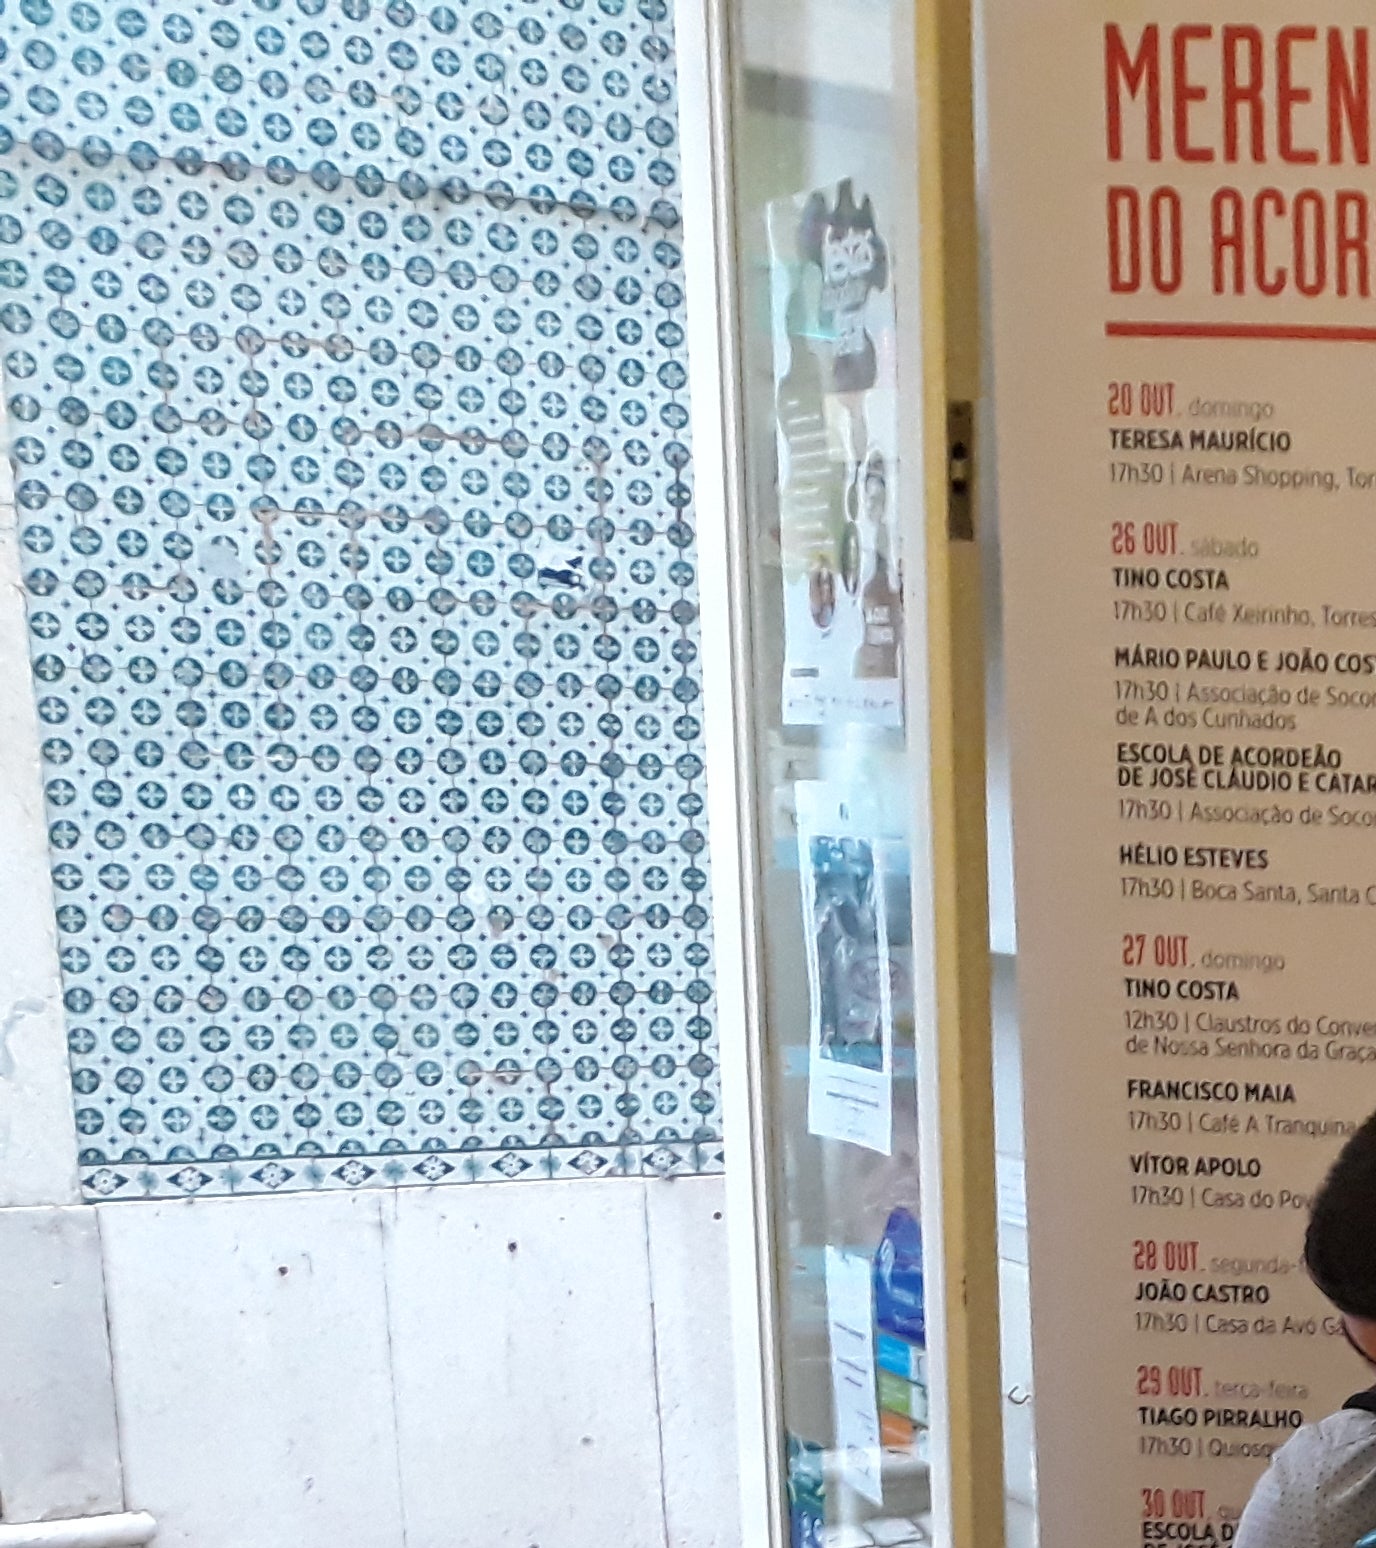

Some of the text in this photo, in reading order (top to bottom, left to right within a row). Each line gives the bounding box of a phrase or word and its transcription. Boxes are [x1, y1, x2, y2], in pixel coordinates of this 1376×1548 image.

[1108, 185, 1181, 295] DO
[1108, 382, 1131, 416] 20
[1189, 399, 1273, 421] domingo
[1109, 429, 1291, 452] TERESA MAURÍCIO
[1109, 463, 1163, 483] 17h30
[1182, 463, 1237, 486] Arena
[1244, 465, 1339, 491] Shopping,
[1112, 522, 1135, 555] 26
[1191, 535, 1258, 557] sábado
[1113, 568, 1229, 590] TINO COSTA
[1114, 601, 1166, 622] 17h30
[1185, 601, 1226, 623] Café
[1322, 606, 1376, 628] Torres
[1115, 644, 1179, 668] MÁRIO
[1185, 649, 1250, 670] PAULO
[1257, 651, 1268, 670] E
[1277, 647, 1327, 672] JOÃO
[1114, 680, 1168, 701] 17h30
[1187, 683, 1290, 706] Associação
[1296, 687, 1318, 705] de
[1116, 706, 1296, 730] de A dos Cunhados
[1118, 743, 1341, 768] ESCOLA DE ACORDEÃO
[1119, 768, 1143, 787] DE
[1150, 765, 1197, 788] JOSÉ
[1203, 767, 1291, 791] CLÁUDIO
[1299, 773, 1310, 792] E
[1119, 800, 1171, 819] 17h30
[1191, 806, 1293, 826] Associação
[1299, 807, 1322, 825] de
[1120, 842, 1268, 869] HÉLIO ESTEVES
[1122, 878, 1173, 897] 17h30
[1192, 880, 1236, 900] Boca
[1244, 883, 1301, 903] Santa,
[1307, 884, 1360, 904] Santa
[1123, 935, 1145, 968] 27
[1201, 951, 1285, 972] domingo
[1125, 978, 1239, 1000] TINO COSTA
[1125, 1011, 1178, 1030] 12h30
[1196, 1013, 1281, 1034] Claustros
[1288, 1018, 1310, 1034] do
[1126, 1037, 1148, 1054] de
[1155, 1037, 1209, 1056] Nossa
[1216, 1038, 1291, 1059] Senhora
[1297, 1042, 1318, 1059] da
[1127, 1080, 1295, 1103] FRANCISCO MAIA
[1129, 1112, 1259, 1134] 17h30 Café A
[1130, 1152, 1261, 1177] VÍTOR APOLO
[1132, 1186, 1274, 1208] 17h30 Casa do
[1134, 1240, 1156, 1271] 28
[1136, 1279, 1269, 1303] JOÃO CASTRO
[1135, 1312, 1315, 1335] 17h30 Casa da Avó
[1137, 1365, 1160, 1396] 29
[1215, 1379, 1308, 1400] terça-feira
[1138, 1407, 1303, 1428] TIAGO PIRRALHO
[1139, 1437, 1191, 1455] 17h30
[1144, 1522, 1212, 1540] ESCOLA
